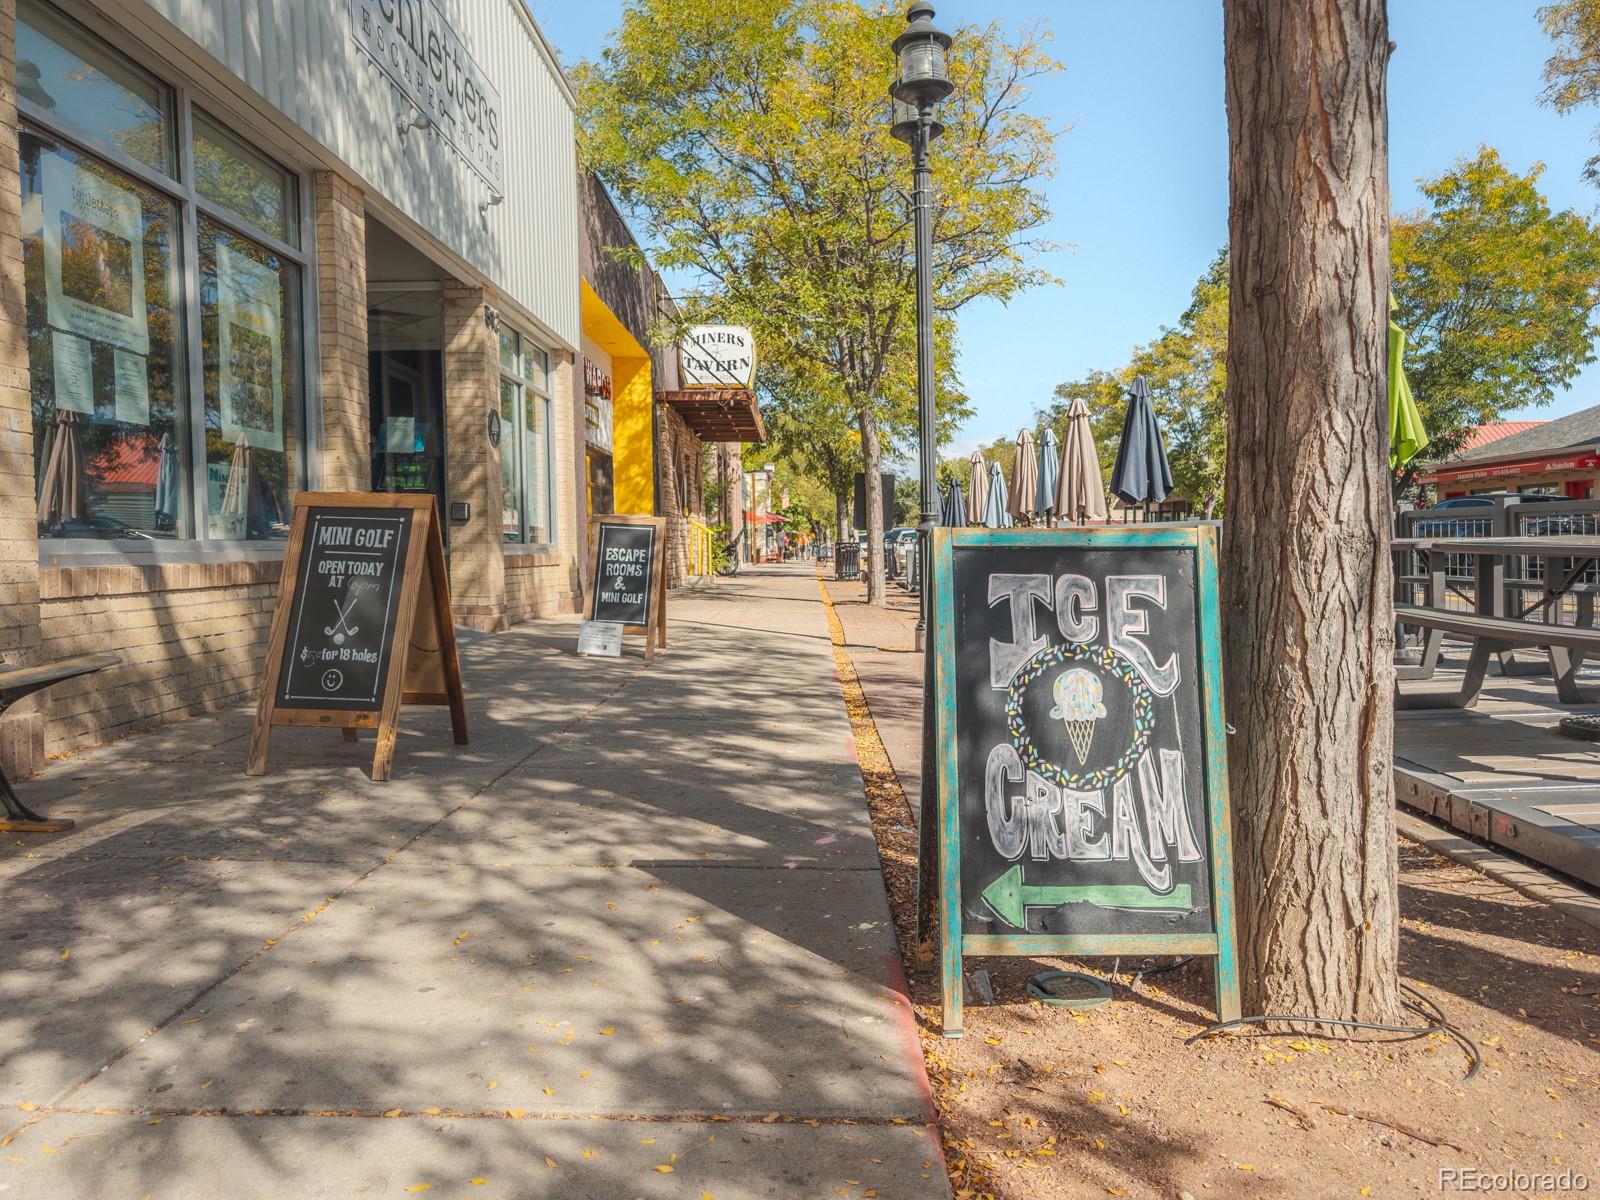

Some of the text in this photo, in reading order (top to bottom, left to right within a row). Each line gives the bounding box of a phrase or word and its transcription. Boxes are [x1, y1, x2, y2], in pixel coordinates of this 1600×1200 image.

[361, 5, 501, 181] ESCAPE ROOMS
[689, 332, 745, 348] MINERS
[684, 356, 750, 372] TAVERN
[318, 526, 394, 548] MINI GOLF
[605, 548, 647, 563] ESCAPE
[318, 560, 384, 577] OPEN TODAY
[606, 563, 643, 577] ROOMS
[328, 575, 345, 588] AT
[614, 576, 626, 590] &
[601, 591, 643, 604] MINI GOLF
[987, 573, 1182, 697] ICE
[321, 647, 339, 661] for
[339, 648, 351, 661] 18
[352, 648, 378, 663] holes
[984, 743, 1204, 893] CREAM
